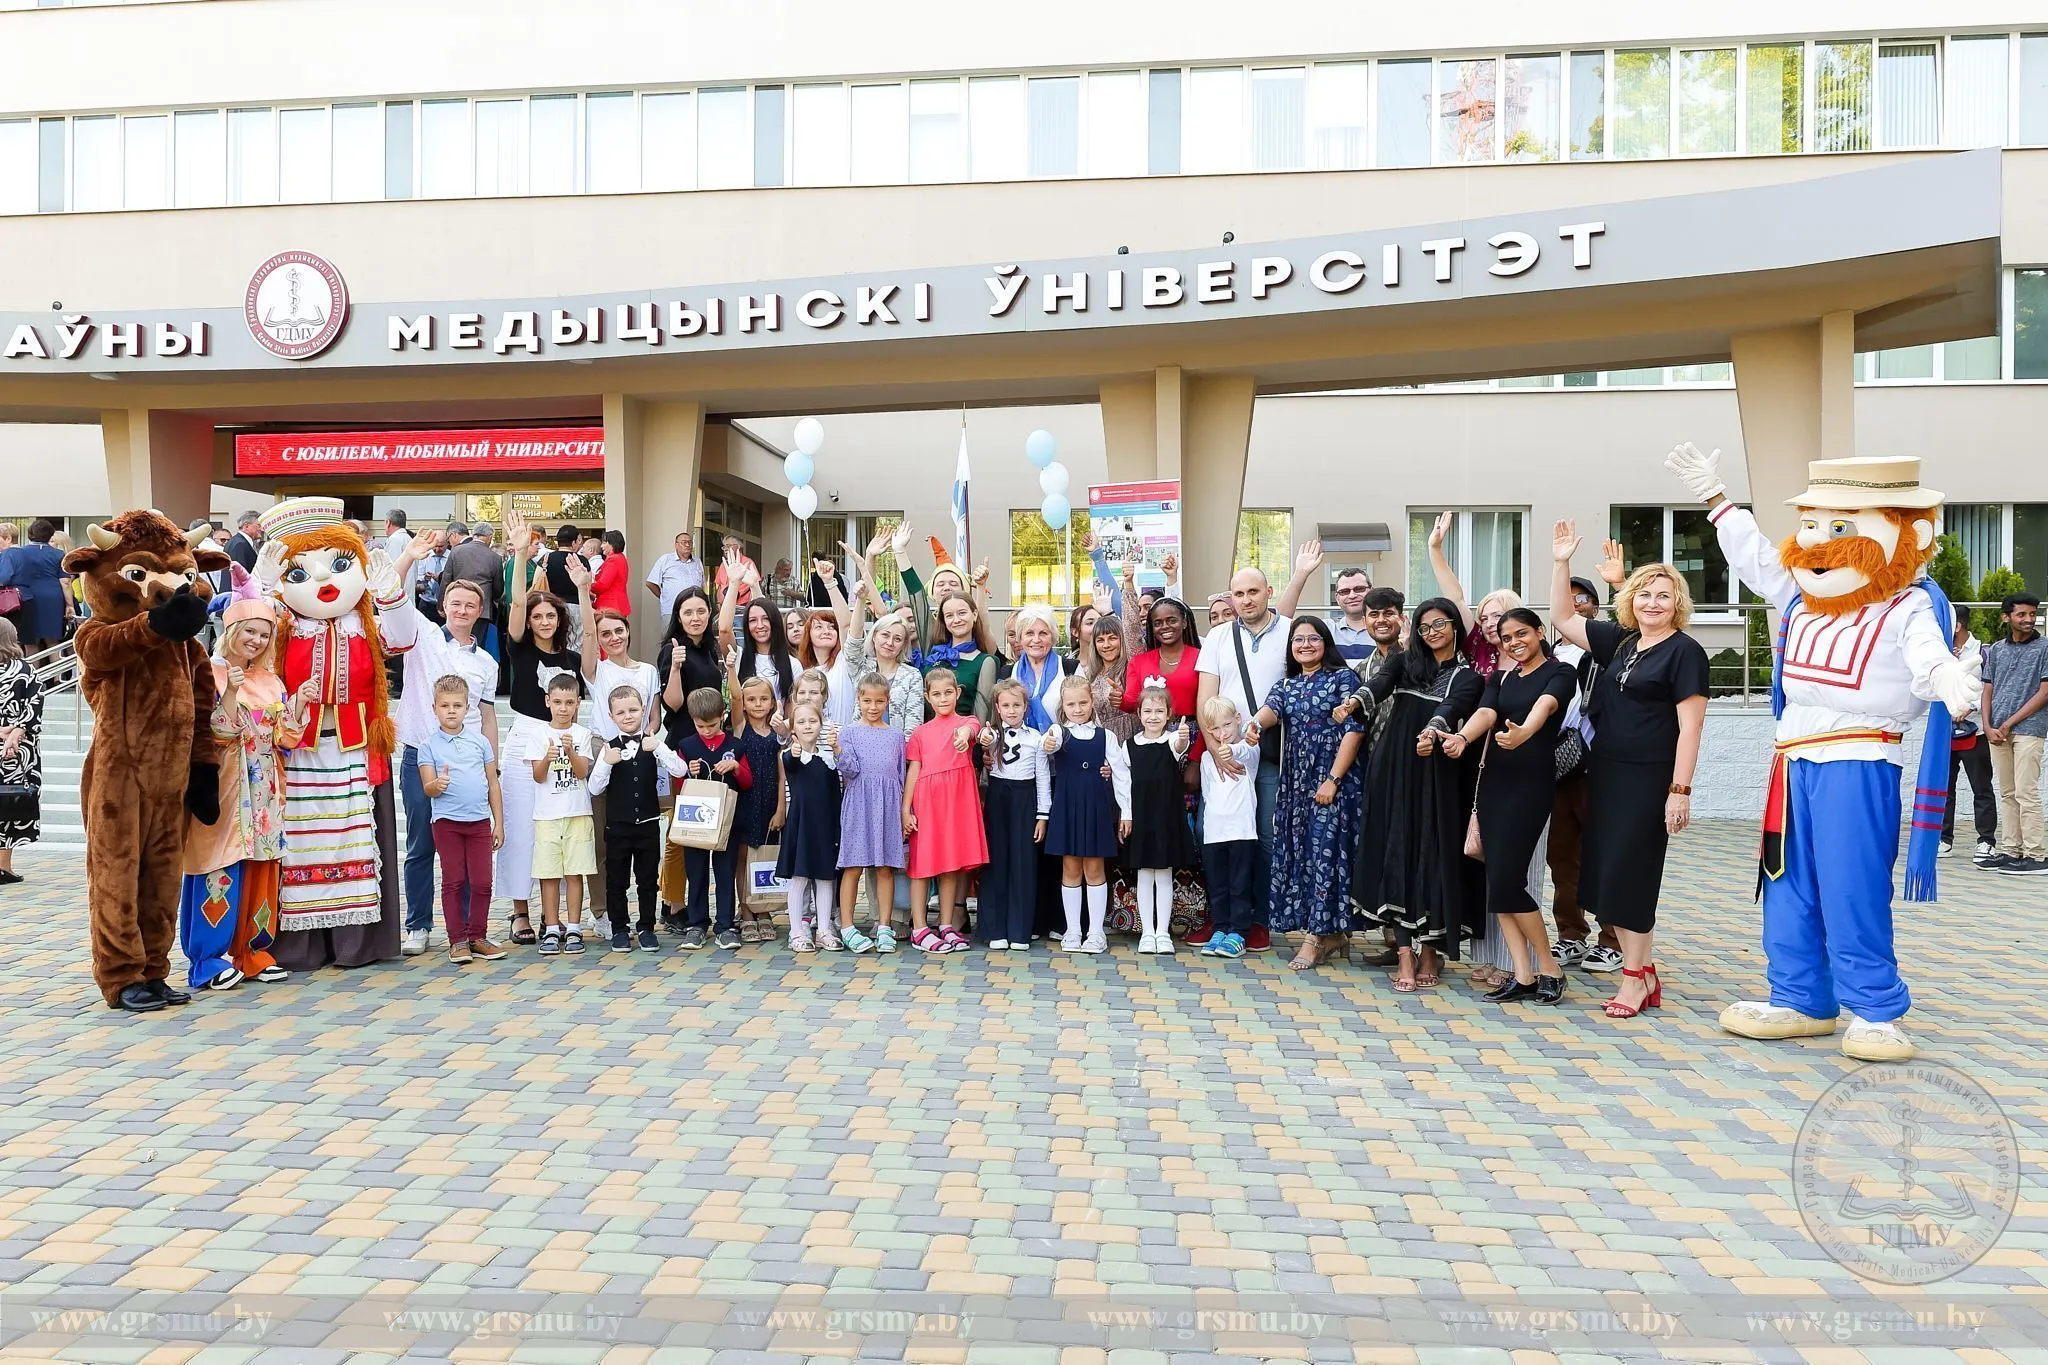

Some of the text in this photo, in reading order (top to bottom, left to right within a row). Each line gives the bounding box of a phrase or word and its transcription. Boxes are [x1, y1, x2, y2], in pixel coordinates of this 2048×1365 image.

[388, 282, 931, 355] МЕДЫЦЫНСКІ
[984, 221, 1606, 316] ЎНІВЕРСІТЭТ
[276, 327, 315, 342] ГДМУ
[282, 447, 294, 461] С
[296, 445, 389, 461] ЮБИЛЕЕМ,
[392, 440, 491, 459] ЛЮБИМЫЙ
[555, 777, 578, 789] MORE
